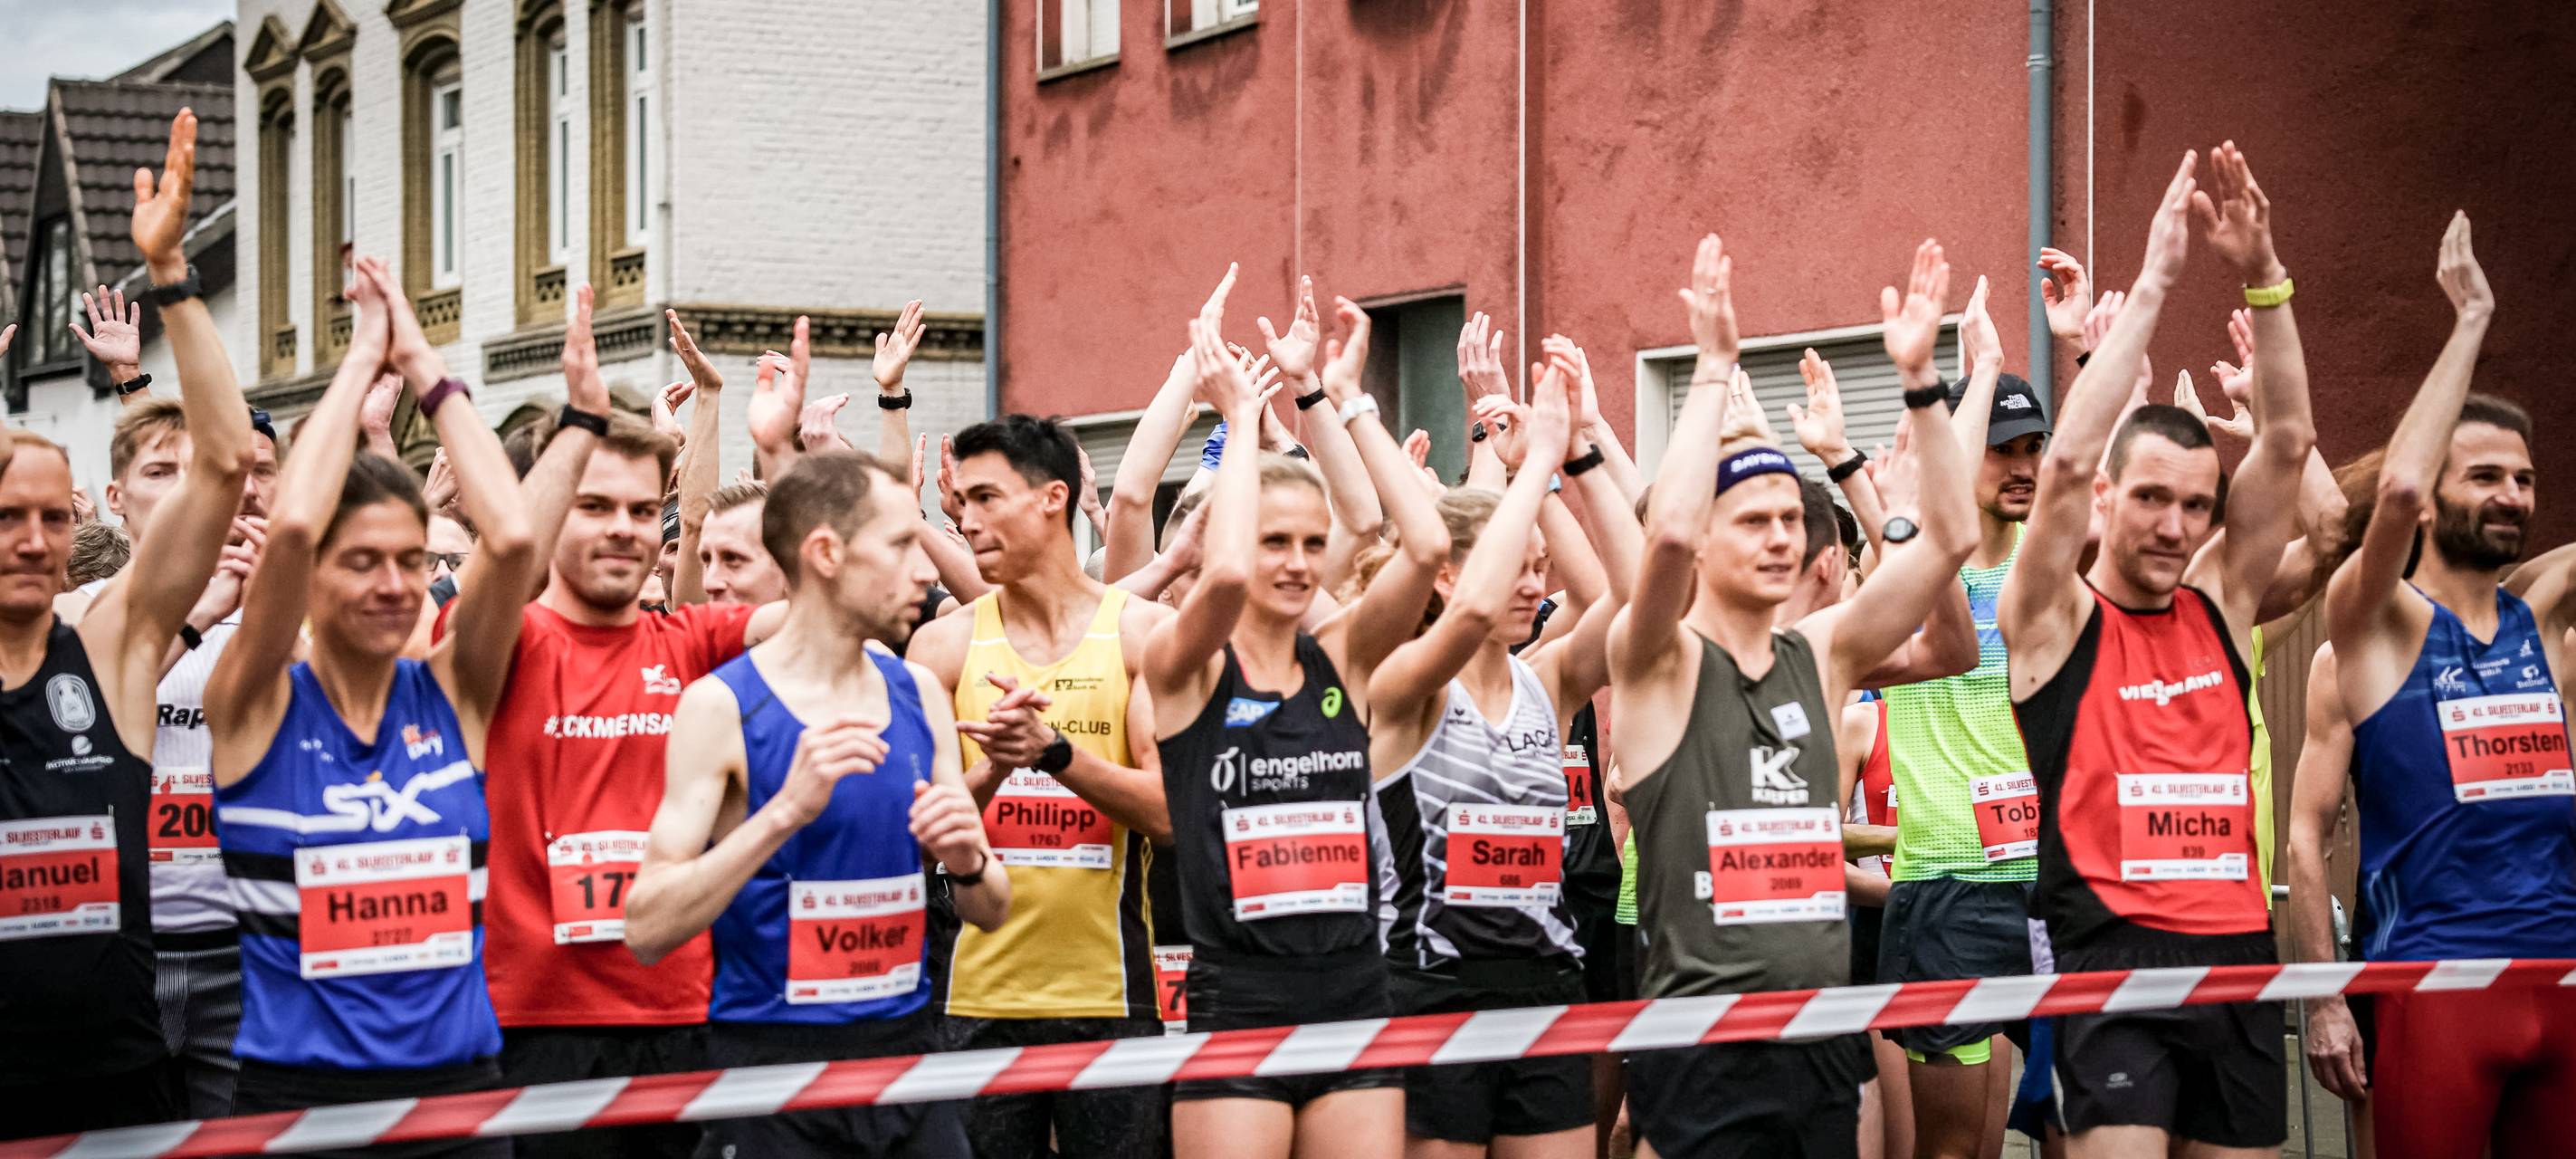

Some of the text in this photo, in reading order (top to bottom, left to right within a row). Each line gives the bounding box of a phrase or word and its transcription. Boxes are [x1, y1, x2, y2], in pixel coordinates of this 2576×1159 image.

[1226, 703, 1265, 722] SAP
[2451, 732, 2565, 759] Thorsten
[1250, 776, 1310, 792] SPORTS
[997, 802, 1096, 832] Philipp
[2148, 811, 2231, 837] Micha
[1030, 834, 1061, 847] 1763
[1472, 839, 1545, 866] Sarah
[1236, 841, 1360, 869] Fabienne
[1720, 847, 1837, 872] Alexander
[0, 856, 100, 890] anuel
[327, 889, 449, 924] Hanna
[816, 923, 909, 953] Volker
